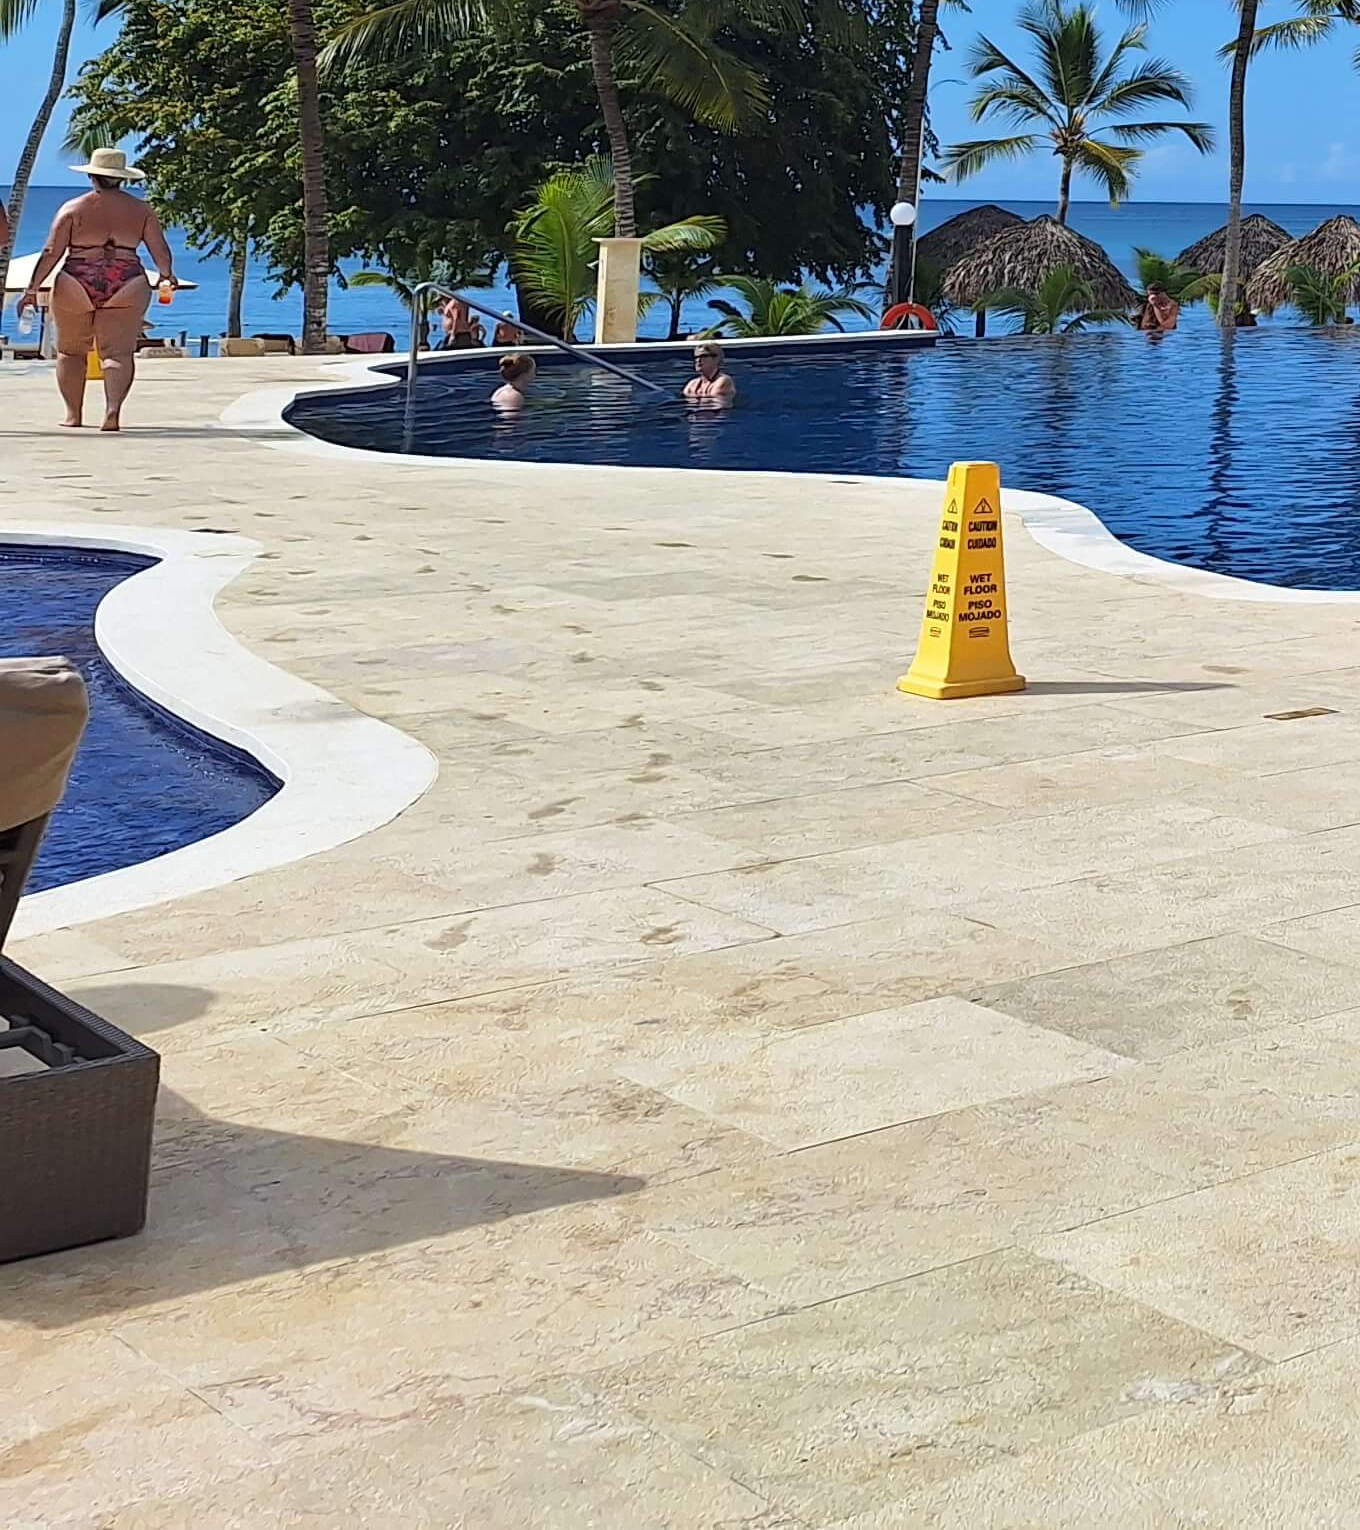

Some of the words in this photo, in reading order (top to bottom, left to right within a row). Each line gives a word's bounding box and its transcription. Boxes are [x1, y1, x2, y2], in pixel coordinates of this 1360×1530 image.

[968, 521, 997, 532] CAUTION
[967, 537, 997, 549] CUIDADO
[969, 573, 993, 583] WET
[963, 583, 998, 596] FLOOR
[967, 599, 993, 610] PISO
[958, 609, 1002, 622] MOJADO
